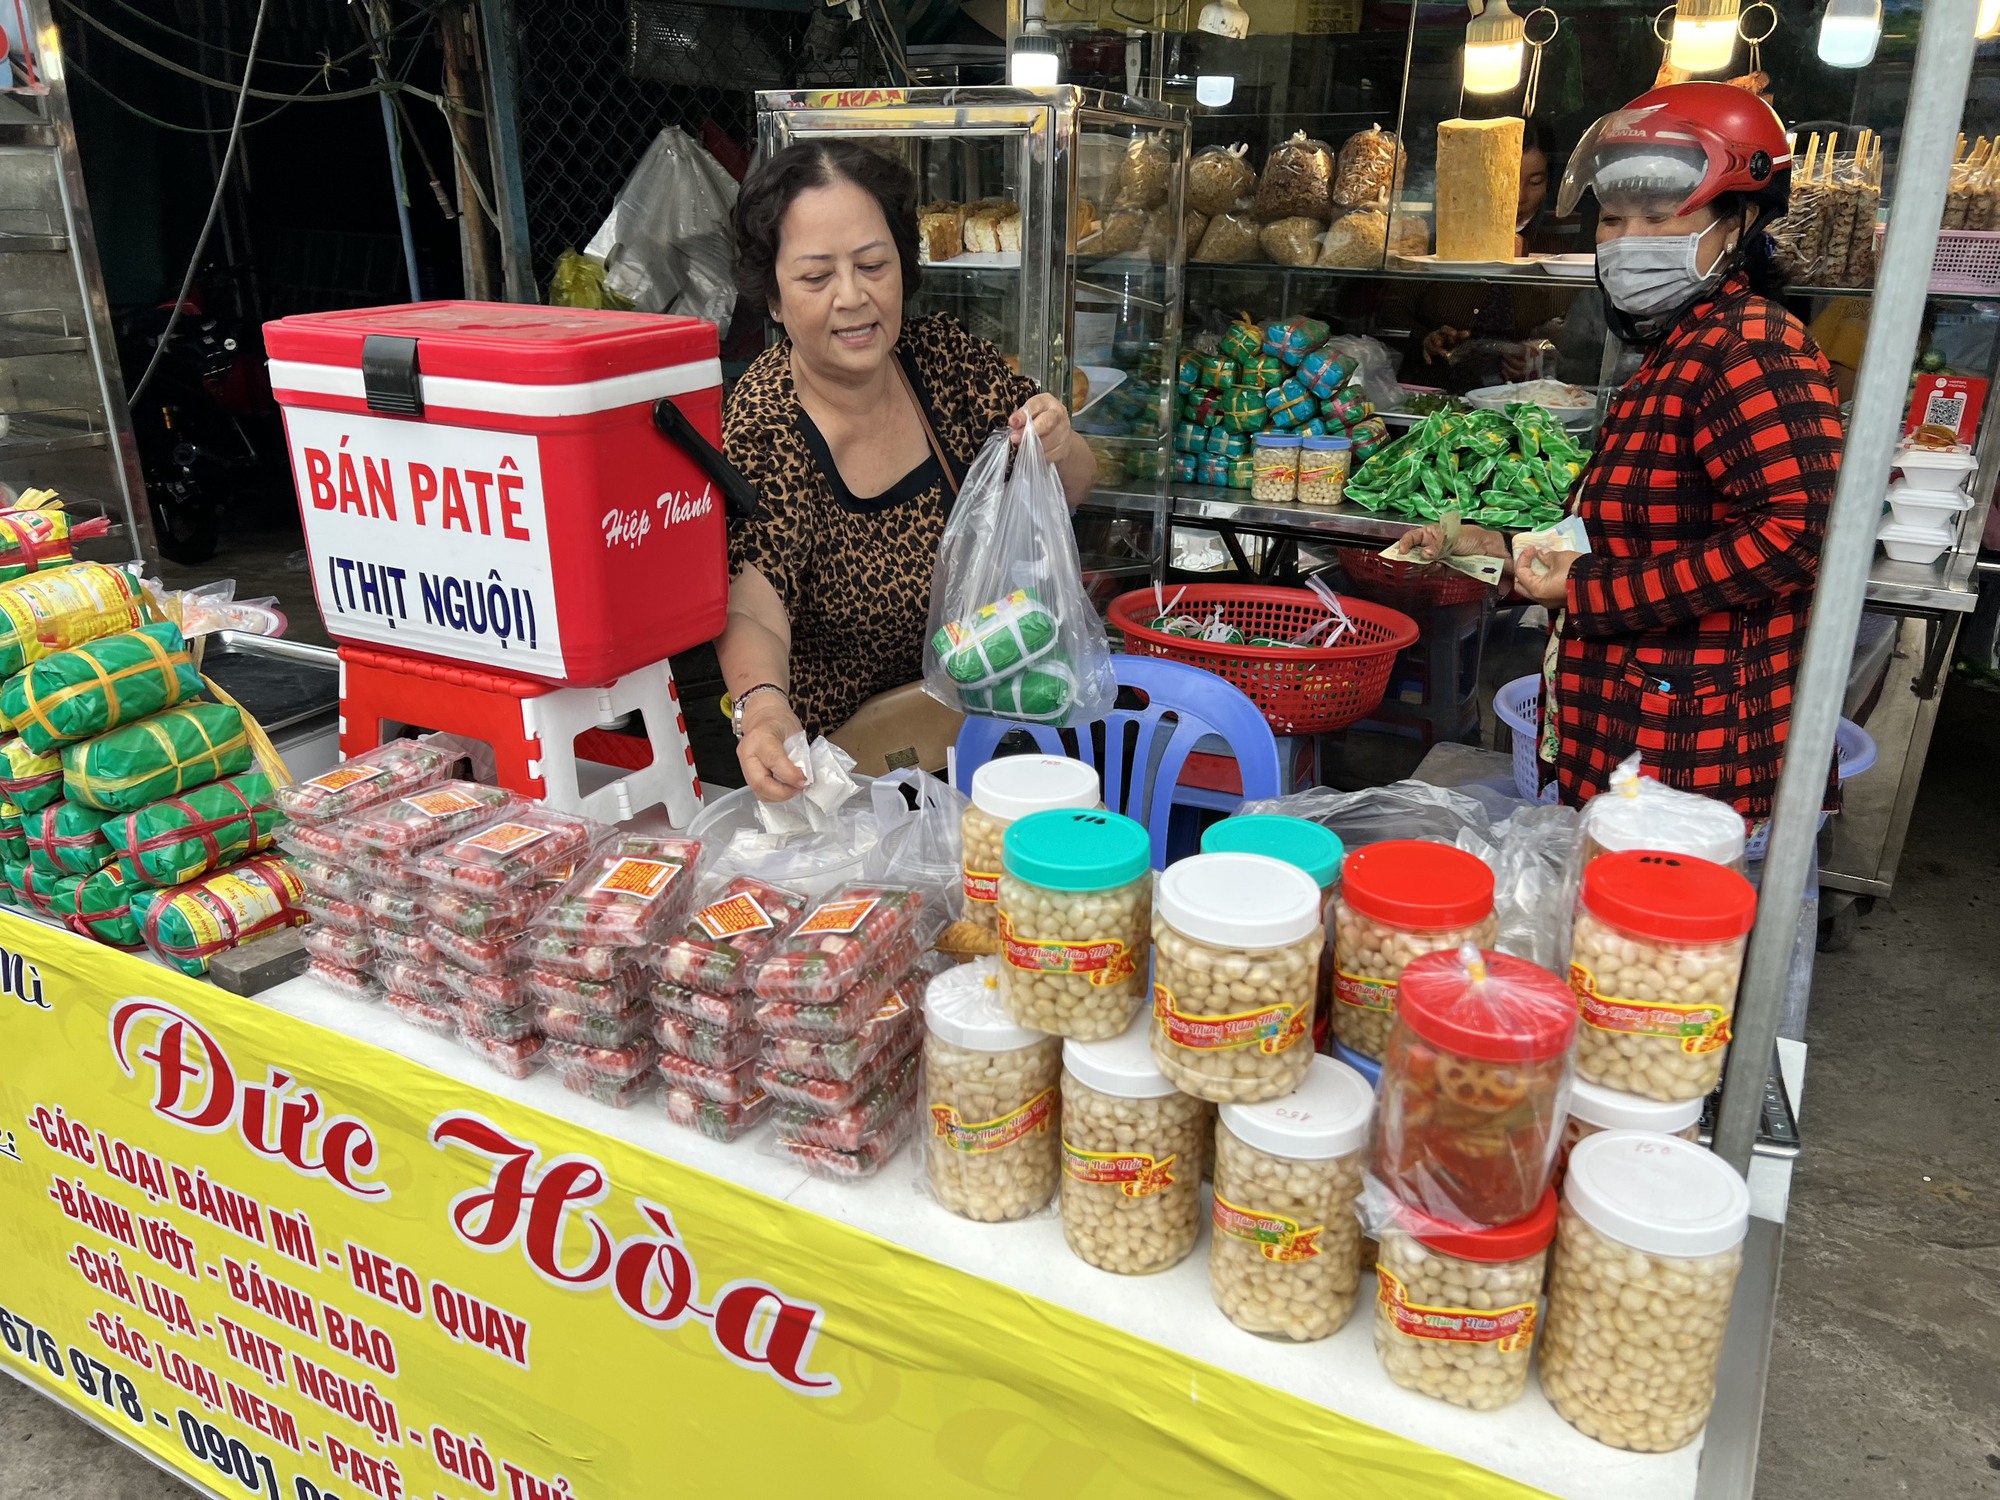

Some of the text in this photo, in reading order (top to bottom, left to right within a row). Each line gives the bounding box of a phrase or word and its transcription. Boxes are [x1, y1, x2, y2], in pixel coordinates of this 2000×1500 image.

[304, 435, 531, 542] BÁN PATÊ
[602, 481, 713, 550] Hiệp Thành
[98, 1131, 168, 1202] LOẠI
[173, 1165, 264, 1243] BÁNH
[269, 1206, 318, 1267] MÌ
[348, 1244, 423, 1314] HEO
[432, 1281, 529, 1365] QUAY
[112, 1001, 833, 1388] Đức Hòa
[139, 1216, 197, 1279] ƯỚT
[226, 1262, 317, 1341] BÁNH
[324, 1312, 396, 1375] BAO
[69, 1347, 145, 1423] 978
[137, 1276, 198, 1337] LỤA
[219, 1315, 287, 1385] THỊT
[293, 1355, 400, 1444] NGUỘI
[432, 1427, 496, 1492] GIÒ
[155, 1342, 224, 1409] LOẠI
[226, 1381, 301, 1452] NEM
[326, 1434, 402, 1500] PATÊ
